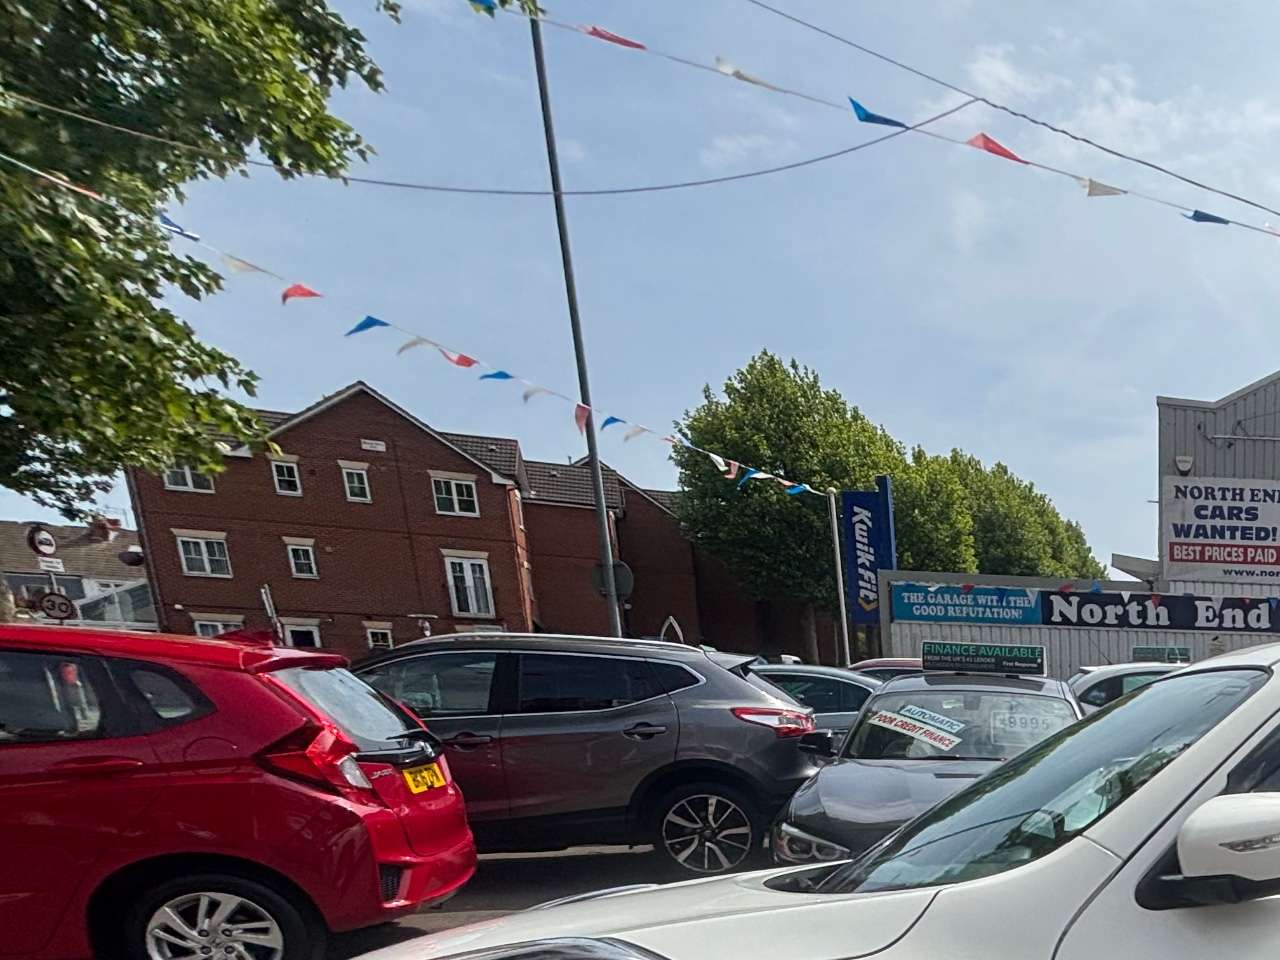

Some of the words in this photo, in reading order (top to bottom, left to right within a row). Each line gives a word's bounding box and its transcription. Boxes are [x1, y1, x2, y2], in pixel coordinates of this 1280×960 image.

[1174, 485, 1244, 502] NORTH
[1194, 505, 1259, 521] CARS
[1172, 523, 1277, 542] WANTED!
[1173, 545, 1202, 560] BEST
[1205, 546, 1244, 561] PRICES
[1247, 547, 1277, 563] PAID
[47, 599, 70, 613] 30
[902, 592, 925, 603] THE
[927, 593, 974, 605] GARAGE
[912, 605, 945, 616] GOOD
[947, 607, 1023, 619] REPUTATION!
[1050, 594, 1171, 627] North
[1194, 600, 1271, 629] End
[923, 643, 976, 655] FINANCE
[978, 646, 1041, 658] AVAILABLE
[904, 707, 961, 731] AUTOMATIC
[874, 713, 897, 725] POOR
[895, 719, 923, 734] CREDIT
[920, 728, 956, 748] FINANCE
